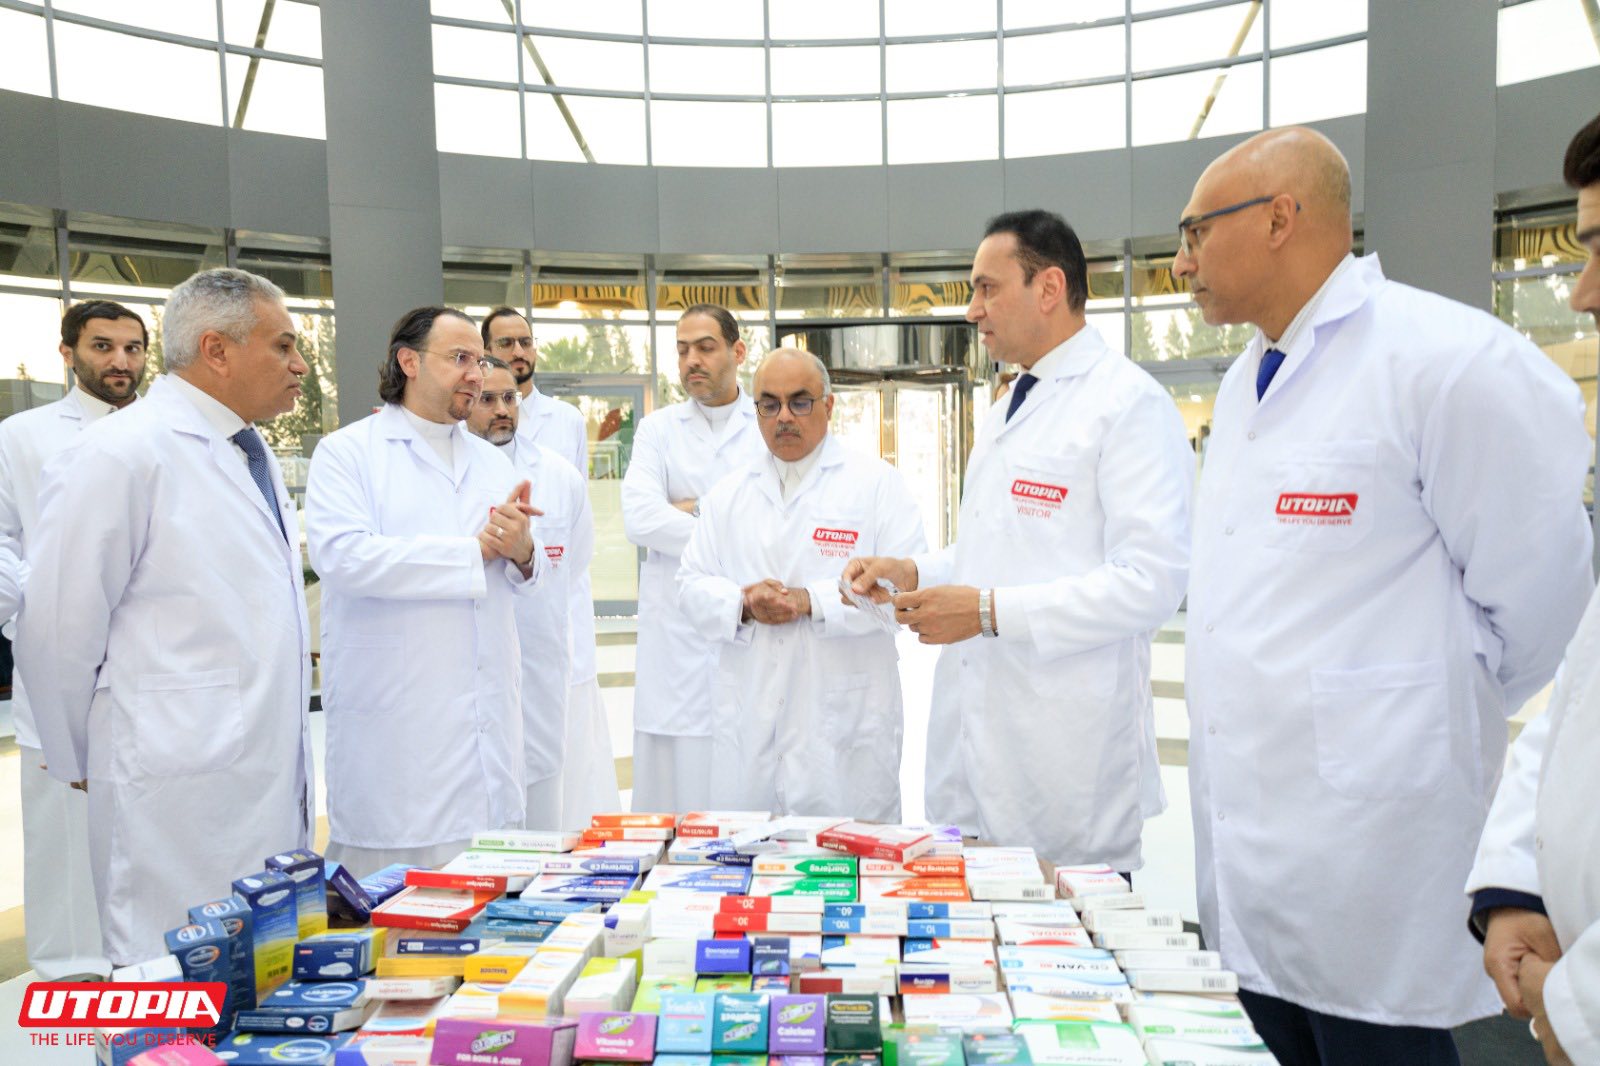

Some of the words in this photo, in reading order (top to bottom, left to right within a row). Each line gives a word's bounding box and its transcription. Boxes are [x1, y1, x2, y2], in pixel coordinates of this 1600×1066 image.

[1013, 481, 1064, 502] UTOPIA
[1279, 497, 1354, 515] UTOPIA
[815, 529, 857, 544] UTOPIA
[742, 899, 755, 909] 20
[841, 906, 853, 916] 60
[927, 905, 935, 915] 5
[738, 917, 748, 926] 30
[835, 919, 850, 929] 100
[926, 925, 936, 935] 10
[777, 1026, 816, 1036] Calcium
